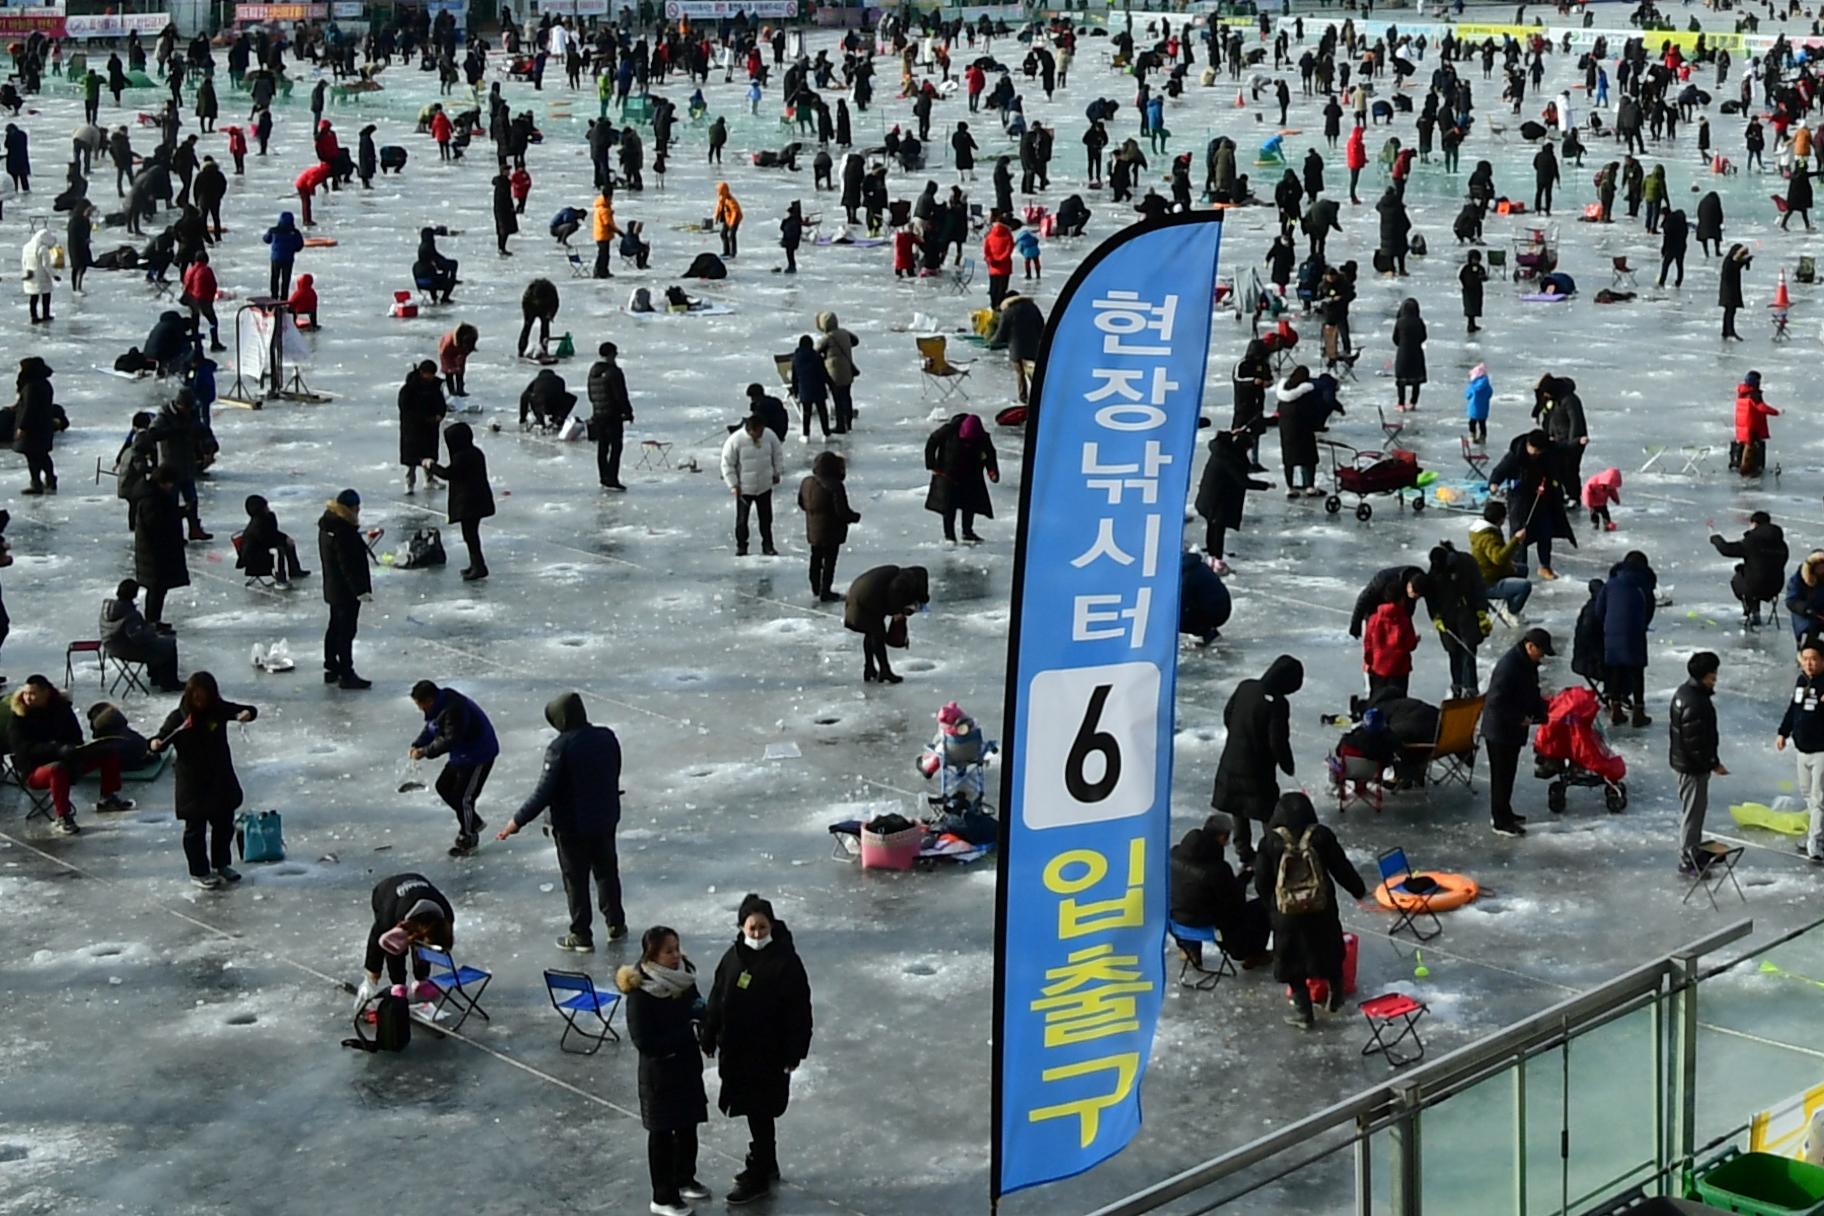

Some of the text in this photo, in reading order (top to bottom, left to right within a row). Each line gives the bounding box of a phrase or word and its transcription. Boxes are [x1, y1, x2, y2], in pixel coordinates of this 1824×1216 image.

[1071, 290, 1179, 650] 현장낚시터
[1065, 684, 1122, 804] 6
[1028, 837, 1153, 1149] 입출구
